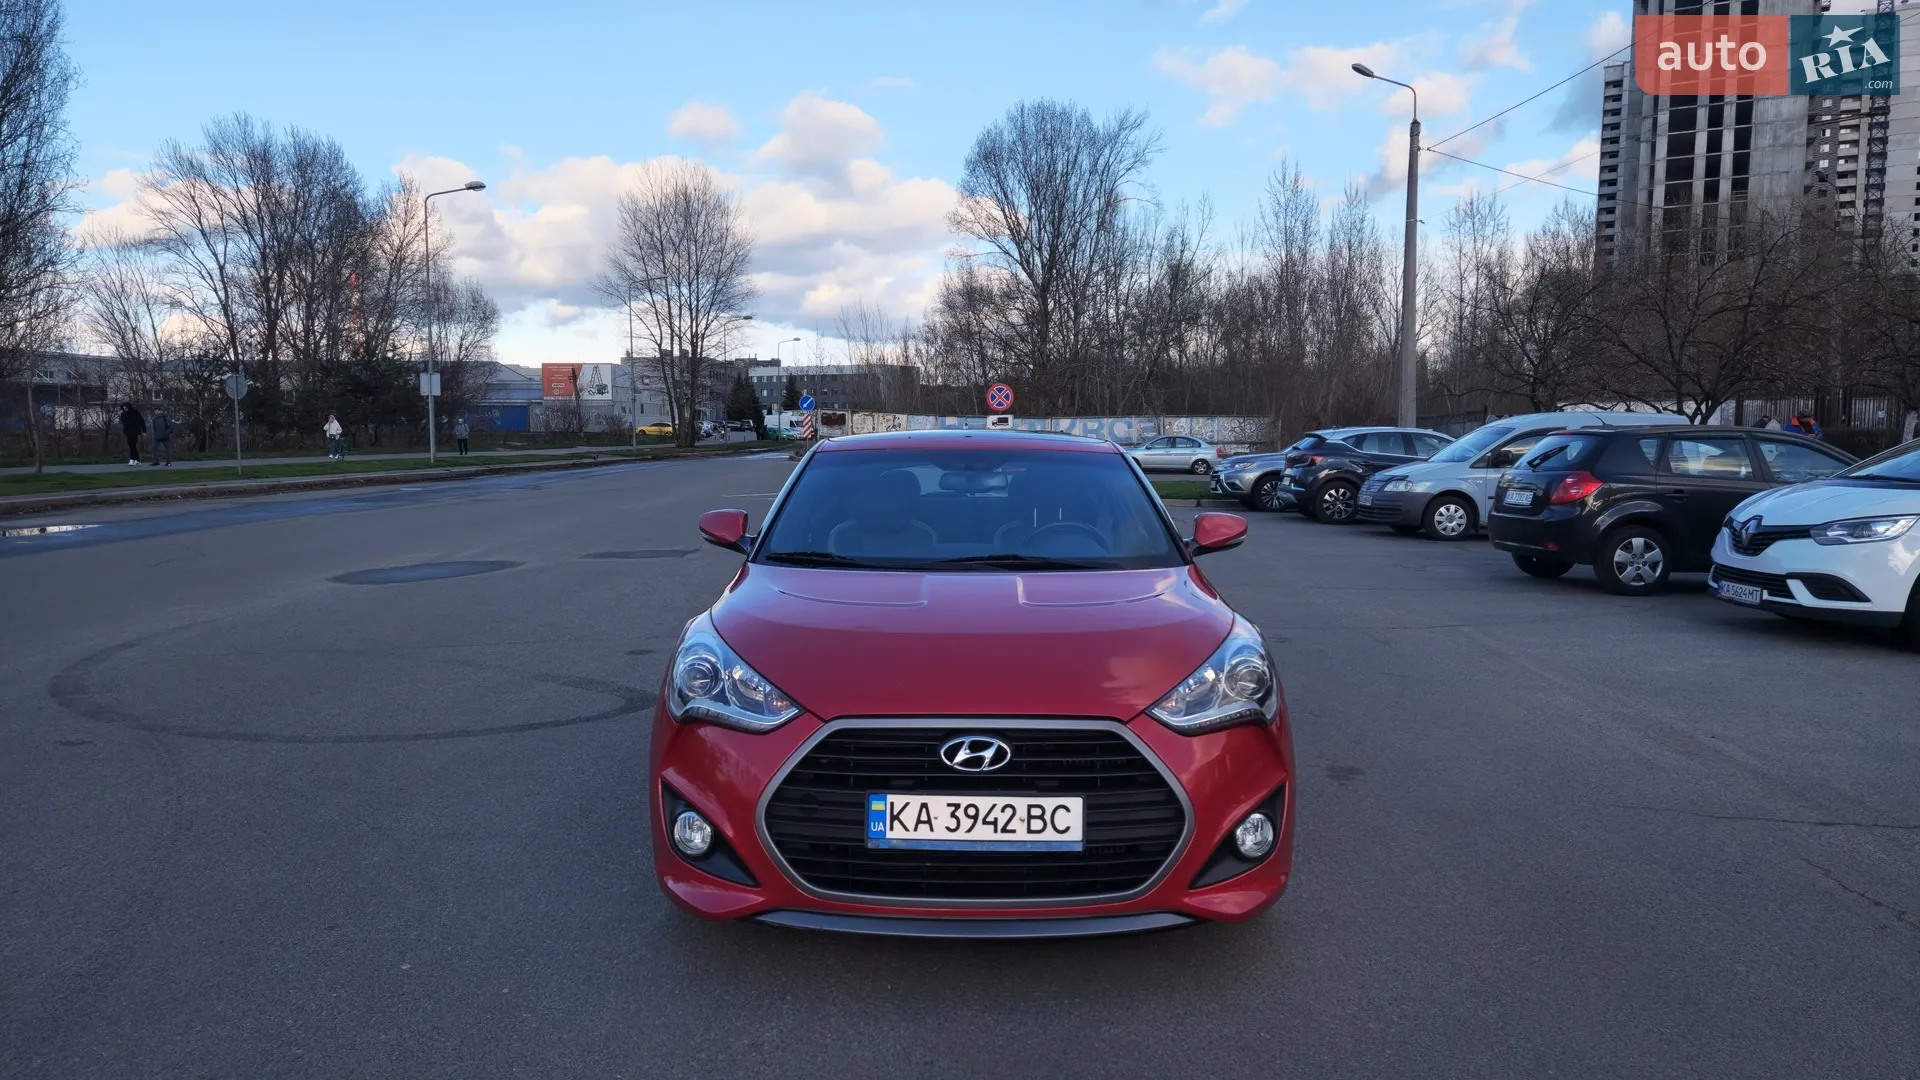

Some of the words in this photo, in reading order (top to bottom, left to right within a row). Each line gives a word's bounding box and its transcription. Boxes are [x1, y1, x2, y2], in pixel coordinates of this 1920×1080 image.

[870, 821, 884, 832] UA
[889, 801, 934, 832] KA
[945, 803, 1017, 834] 3942
[1026, 803, 1071, 835] BC
